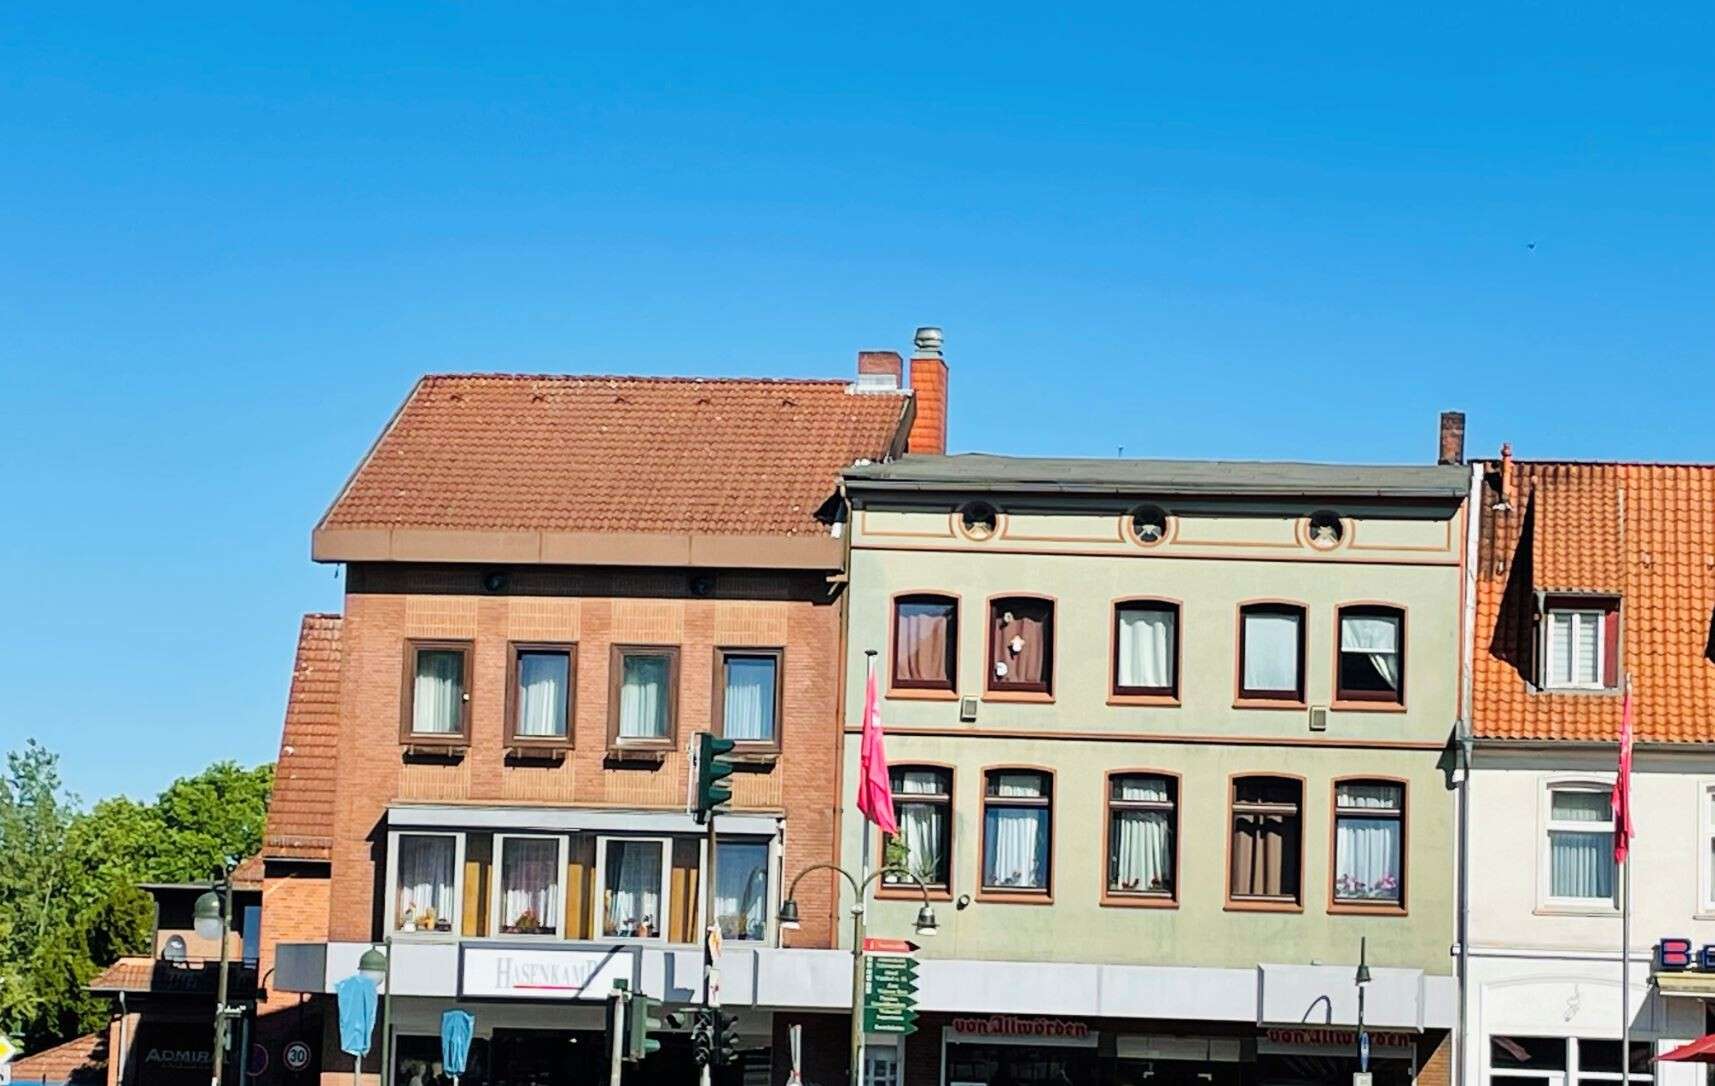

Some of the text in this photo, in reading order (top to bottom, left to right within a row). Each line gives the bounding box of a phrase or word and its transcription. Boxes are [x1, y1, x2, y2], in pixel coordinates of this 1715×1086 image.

[953, 1018, 988, 1034] von
[145, 1048, 231, 1064] ADMIRL
[290, 1049, 304, 1062] 30
